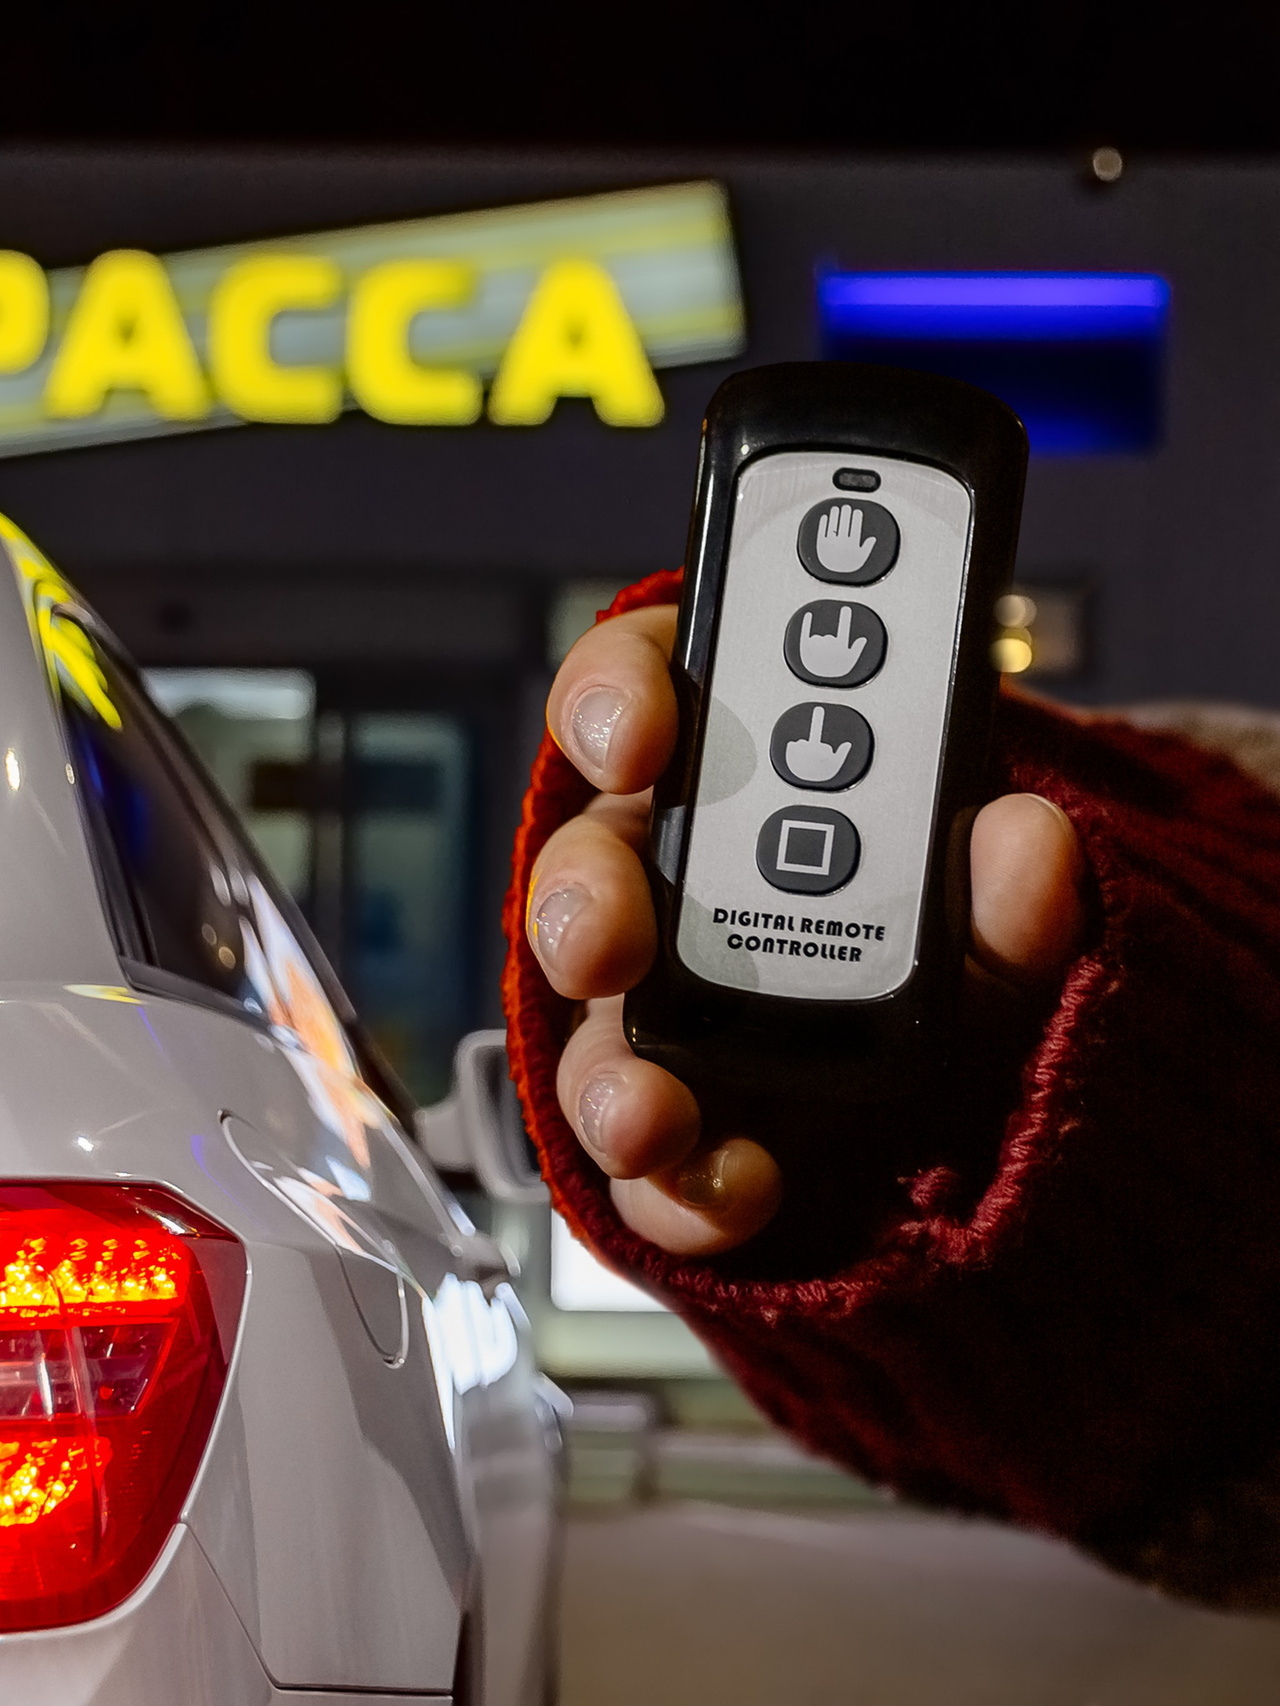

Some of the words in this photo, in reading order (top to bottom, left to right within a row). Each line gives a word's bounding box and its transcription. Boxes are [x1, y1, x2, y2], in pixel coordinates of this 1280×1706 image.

[712, 907, 795, 932] DIGITAL
[800, 917, 886, 942] REMOTE
[726, 933, 863, 963] CONTROLLER
